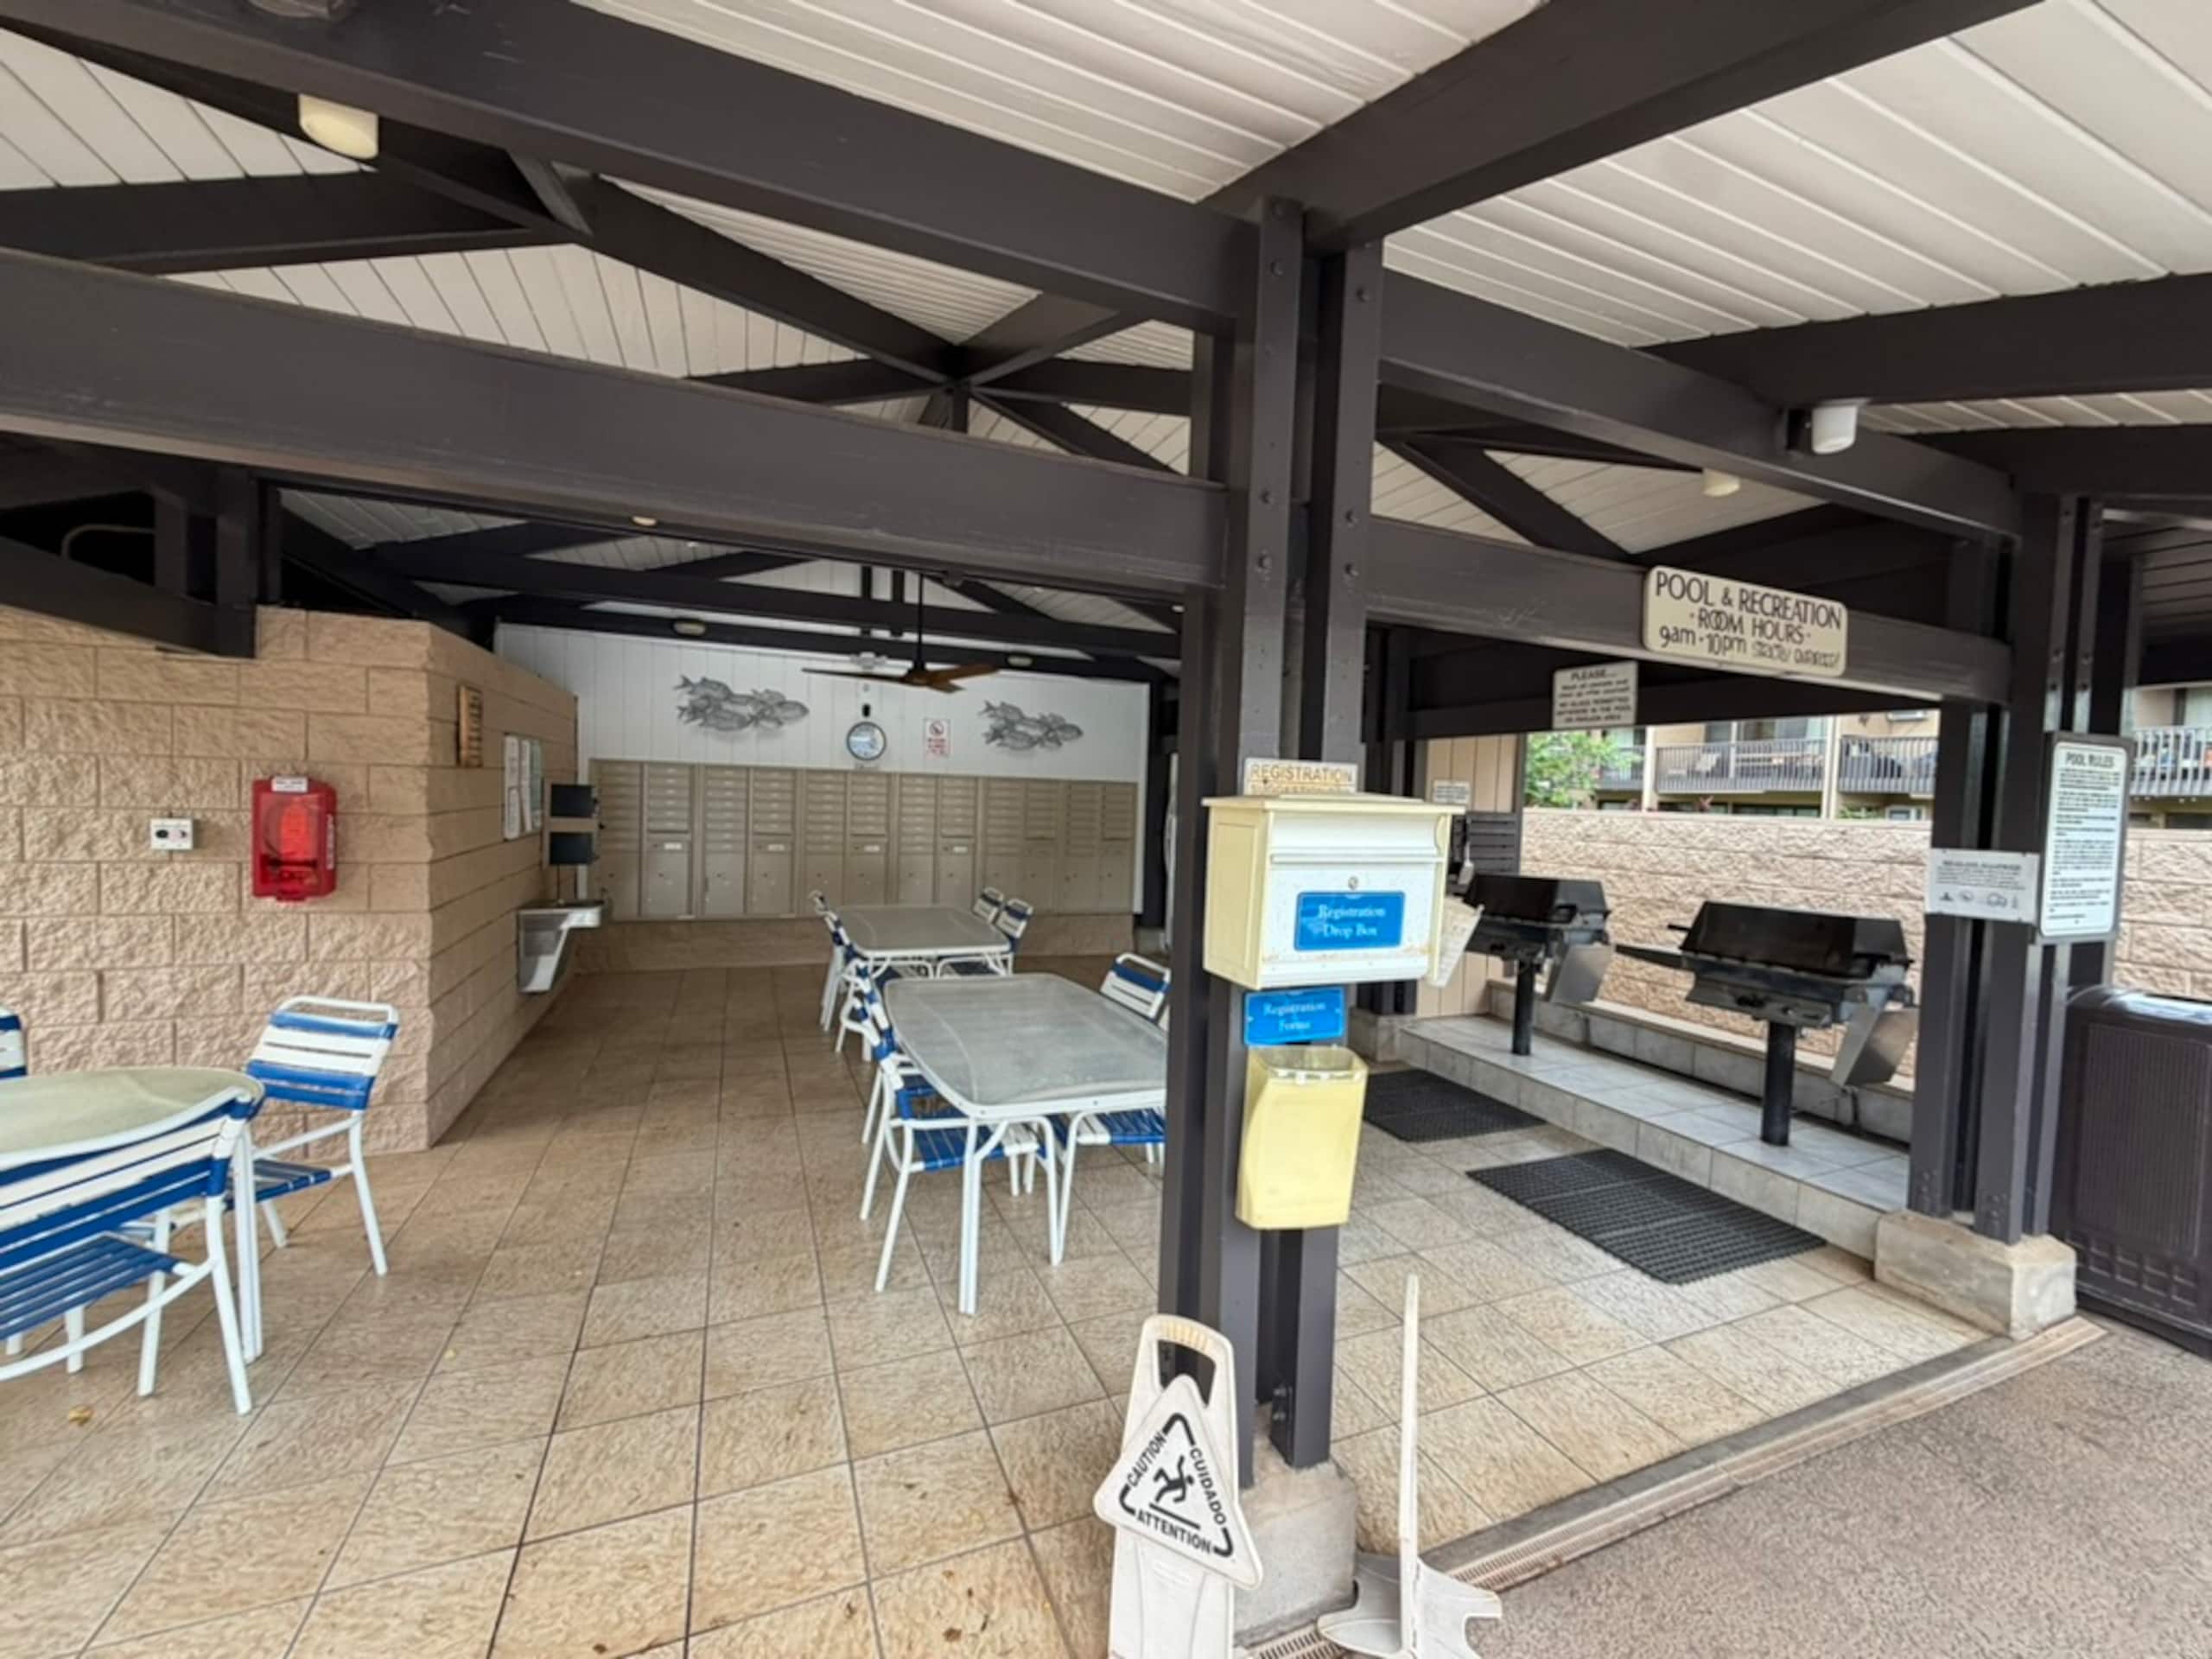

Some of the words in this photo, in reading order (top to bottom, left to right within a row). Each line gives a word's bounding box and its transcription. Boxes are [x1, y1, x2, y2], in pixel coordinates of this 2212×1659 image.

[1656, 570, 1714, 607] POOL
[1721, 587, 1734, 607] &
[1739, 588, 1841, 629] RECREATION
[1698, 607, 1744, 635] ROOM
[1752, 618, 1805, 645] HOURS
[1250, 763, 1352, 782] REGISTRATION
[1318, 903, 1386, 919] Registration
[1324, 923, 1353, 940] Drop
[1357, 922, 1378, 936] Box
[1263, 1001, 1327, 1016] Registration
[1126, 1431, 1167, 1488] CAUTION
[1189, 1446, 1227, 1526] CUIDADO
[1137, 1508, 1211, 1554] ATTENTION
